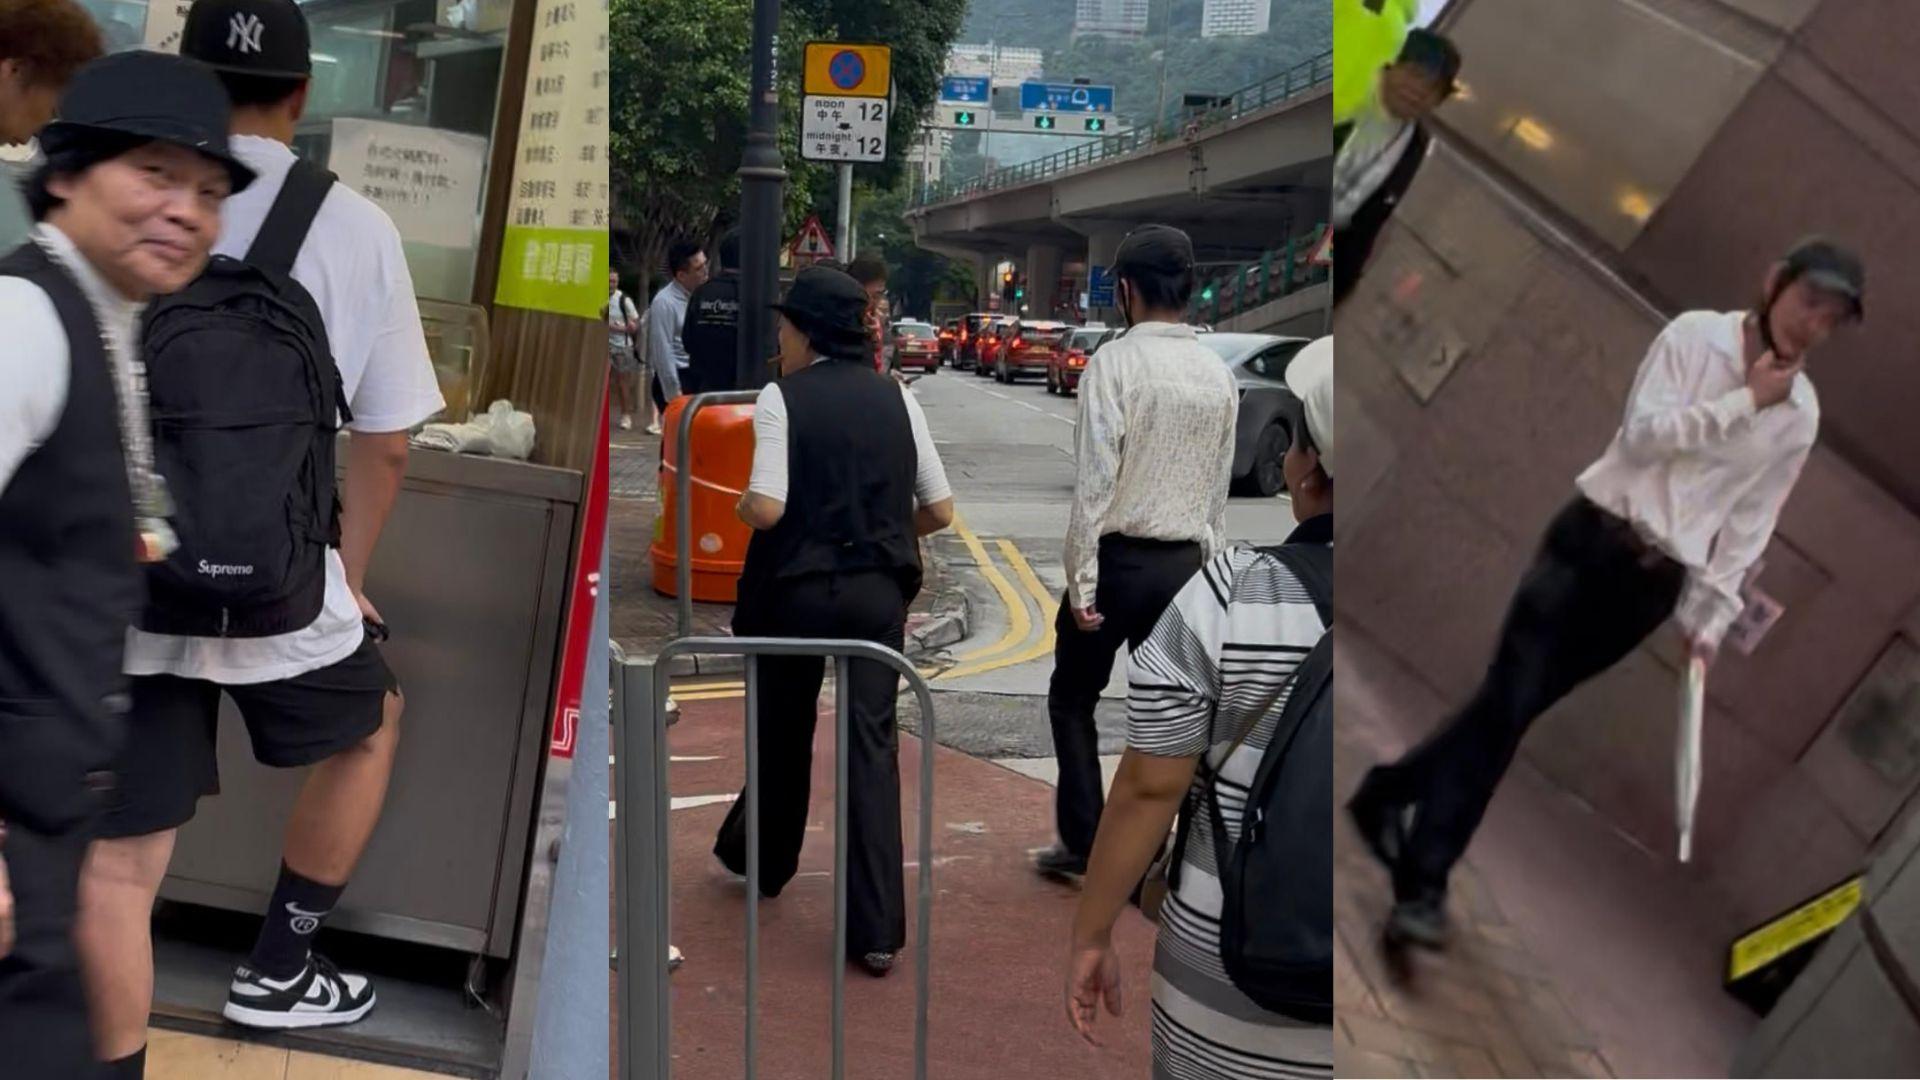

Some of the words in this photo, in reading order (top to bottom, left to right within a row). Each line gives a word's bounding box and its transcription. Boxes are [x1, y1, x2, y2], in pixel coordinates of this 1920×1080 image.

[225, 11, 265, 54] NY
[815, 100, 845, 108] noon
[858, 102, 883, 121] 12
[817, 110, 842, 121] 中午
[806, 131, 851, 142] midnight
[857, 136, 882, 155] 12
[198, 559, 253, 578] Supreme
